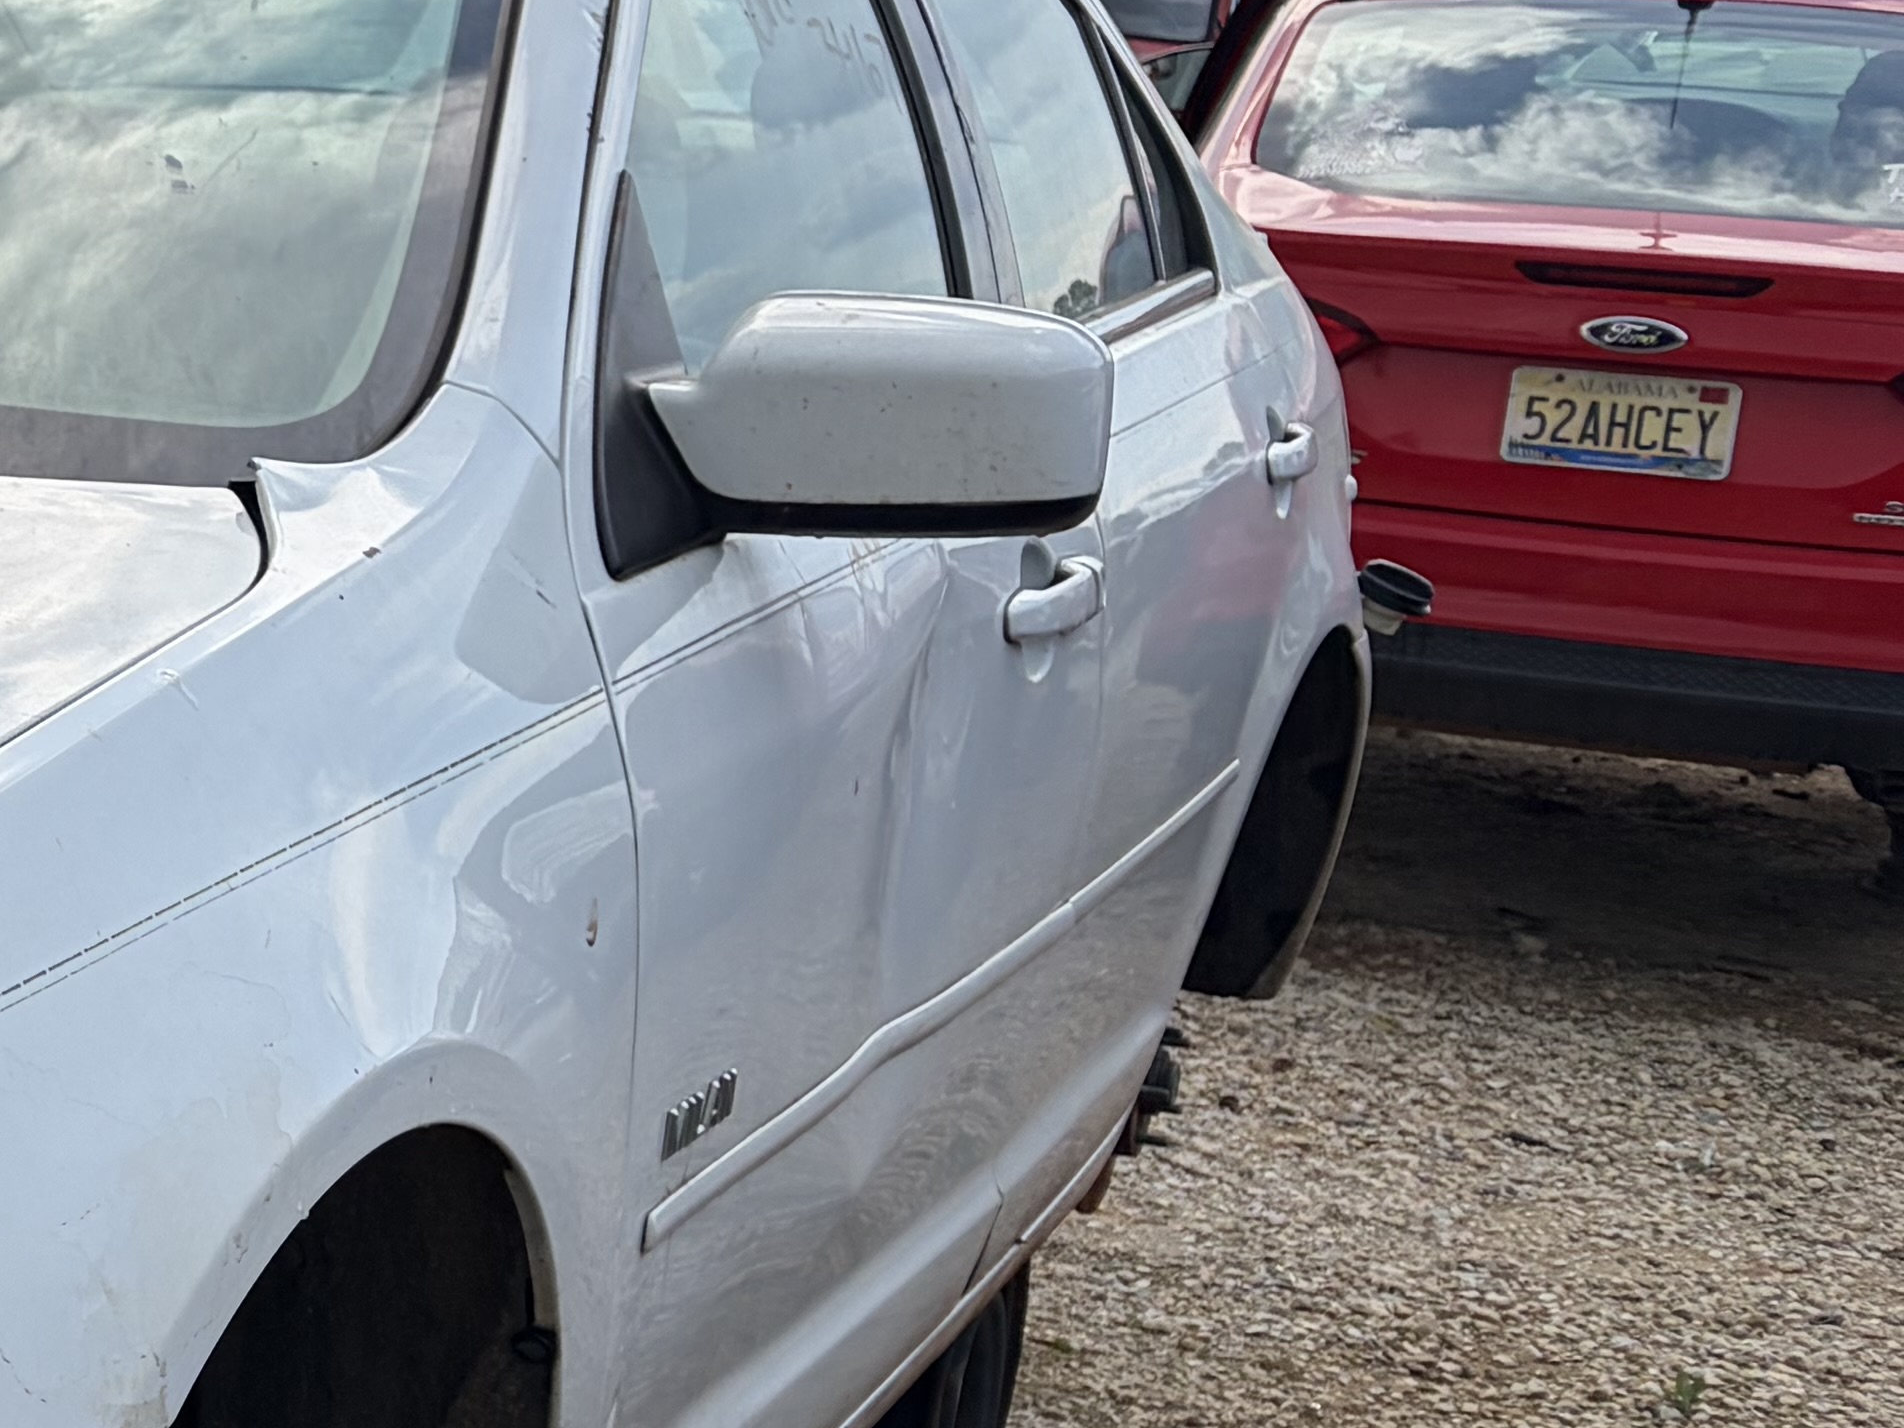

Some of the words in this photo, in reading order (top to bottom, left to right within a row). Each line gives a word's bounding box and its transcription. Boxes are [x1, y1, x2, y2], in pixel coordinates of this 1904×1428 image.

[1602, 322, 1660, 347] Ford
[1572, 377, 1679, 400] ALABAMA
[1522, 395, 1720, 459] 52AHCEY
